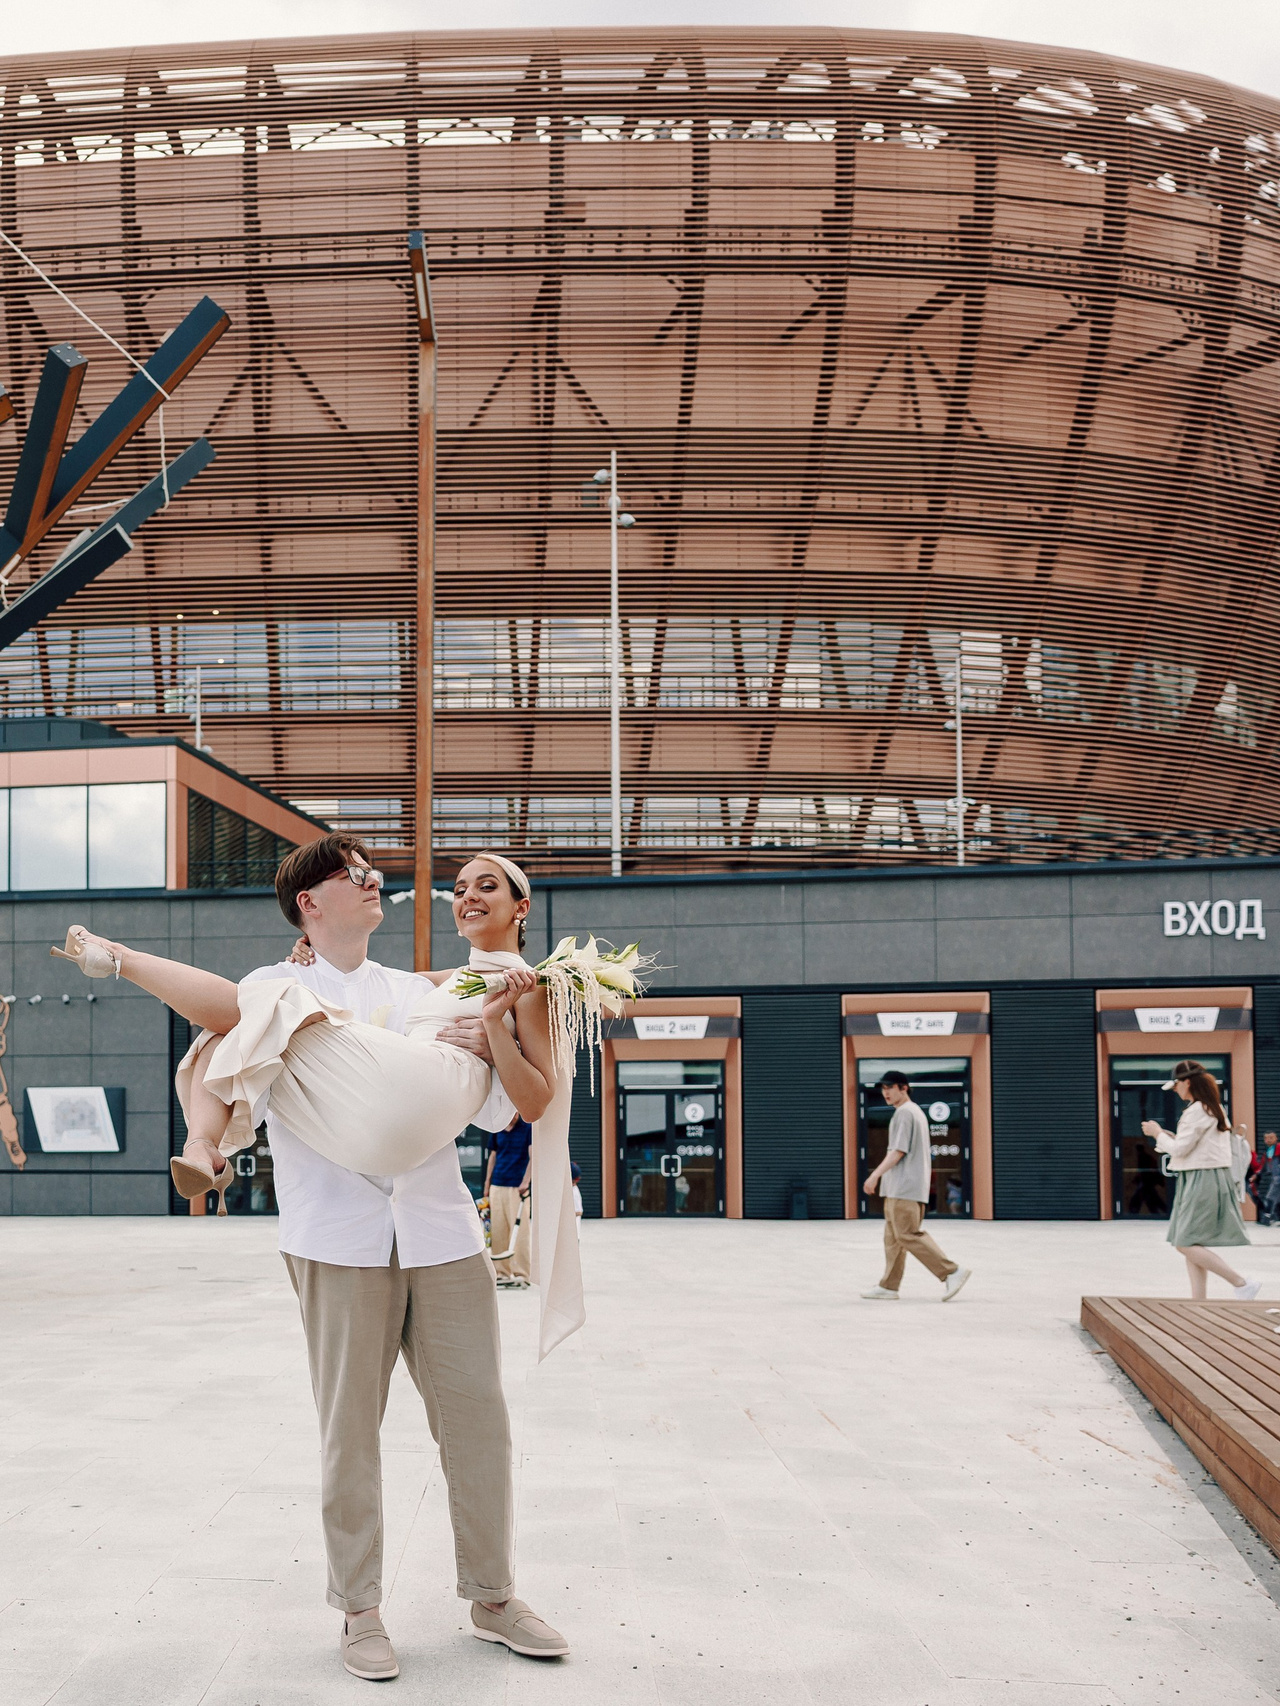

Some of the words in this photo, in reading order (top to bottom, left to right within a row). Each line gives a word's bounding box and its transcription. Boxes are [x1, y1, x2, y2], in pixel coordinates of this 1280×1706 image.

[1163, 899, 1266, 941] ВХОД
[915, 1016, 923, 1030] 2
[1174, 1012, 1183, 1027] 2
[668, 1020, 676, 1034] 2
[690, 1106, 699, 1119] 2
[935, 1105, 944, 1118] 2
